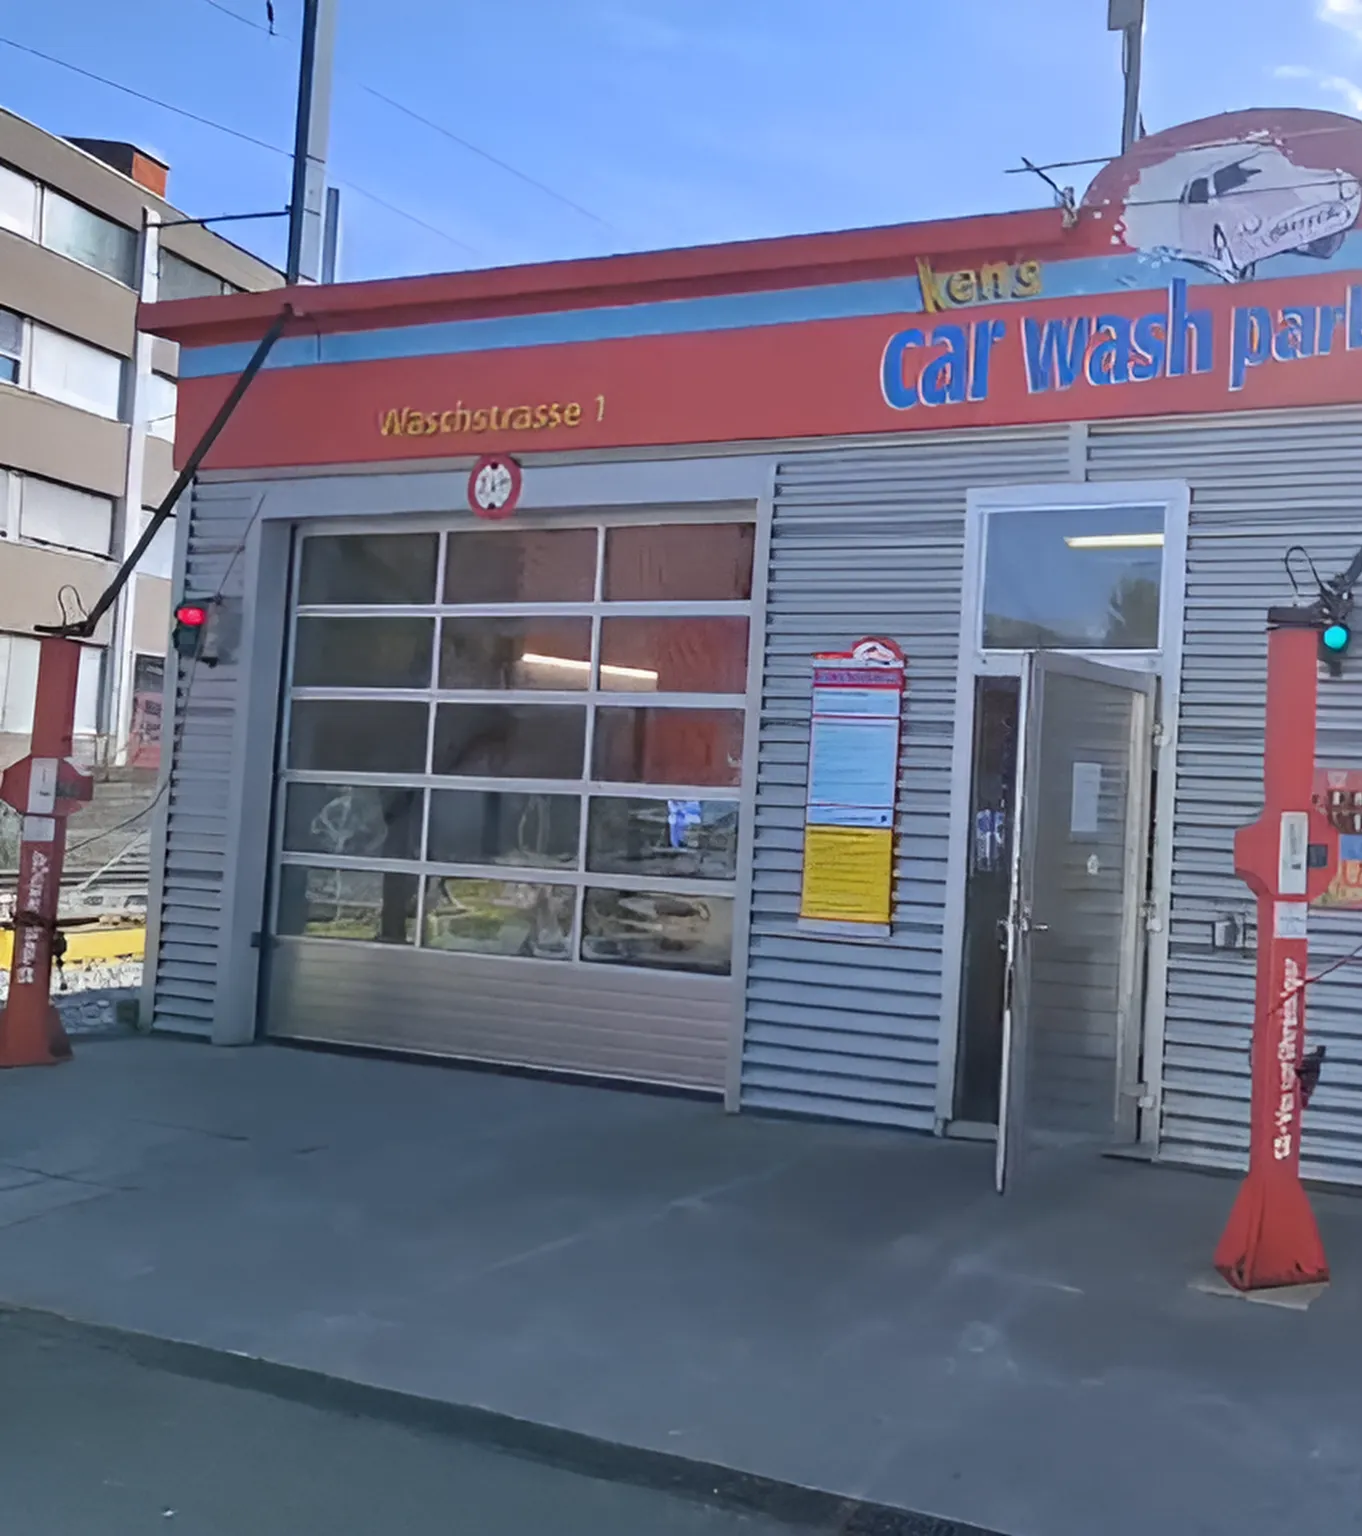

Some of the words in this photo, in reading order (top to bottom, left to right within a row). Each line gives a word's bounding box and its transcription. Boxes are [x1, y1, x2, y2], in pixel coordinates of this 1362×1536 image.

[879, 319, 1006, 411] car
[1020, 277, 1214, 394] wash
[379, 401, 582, 436] Waschstrasse
[594, 394, 605, 422] 1
